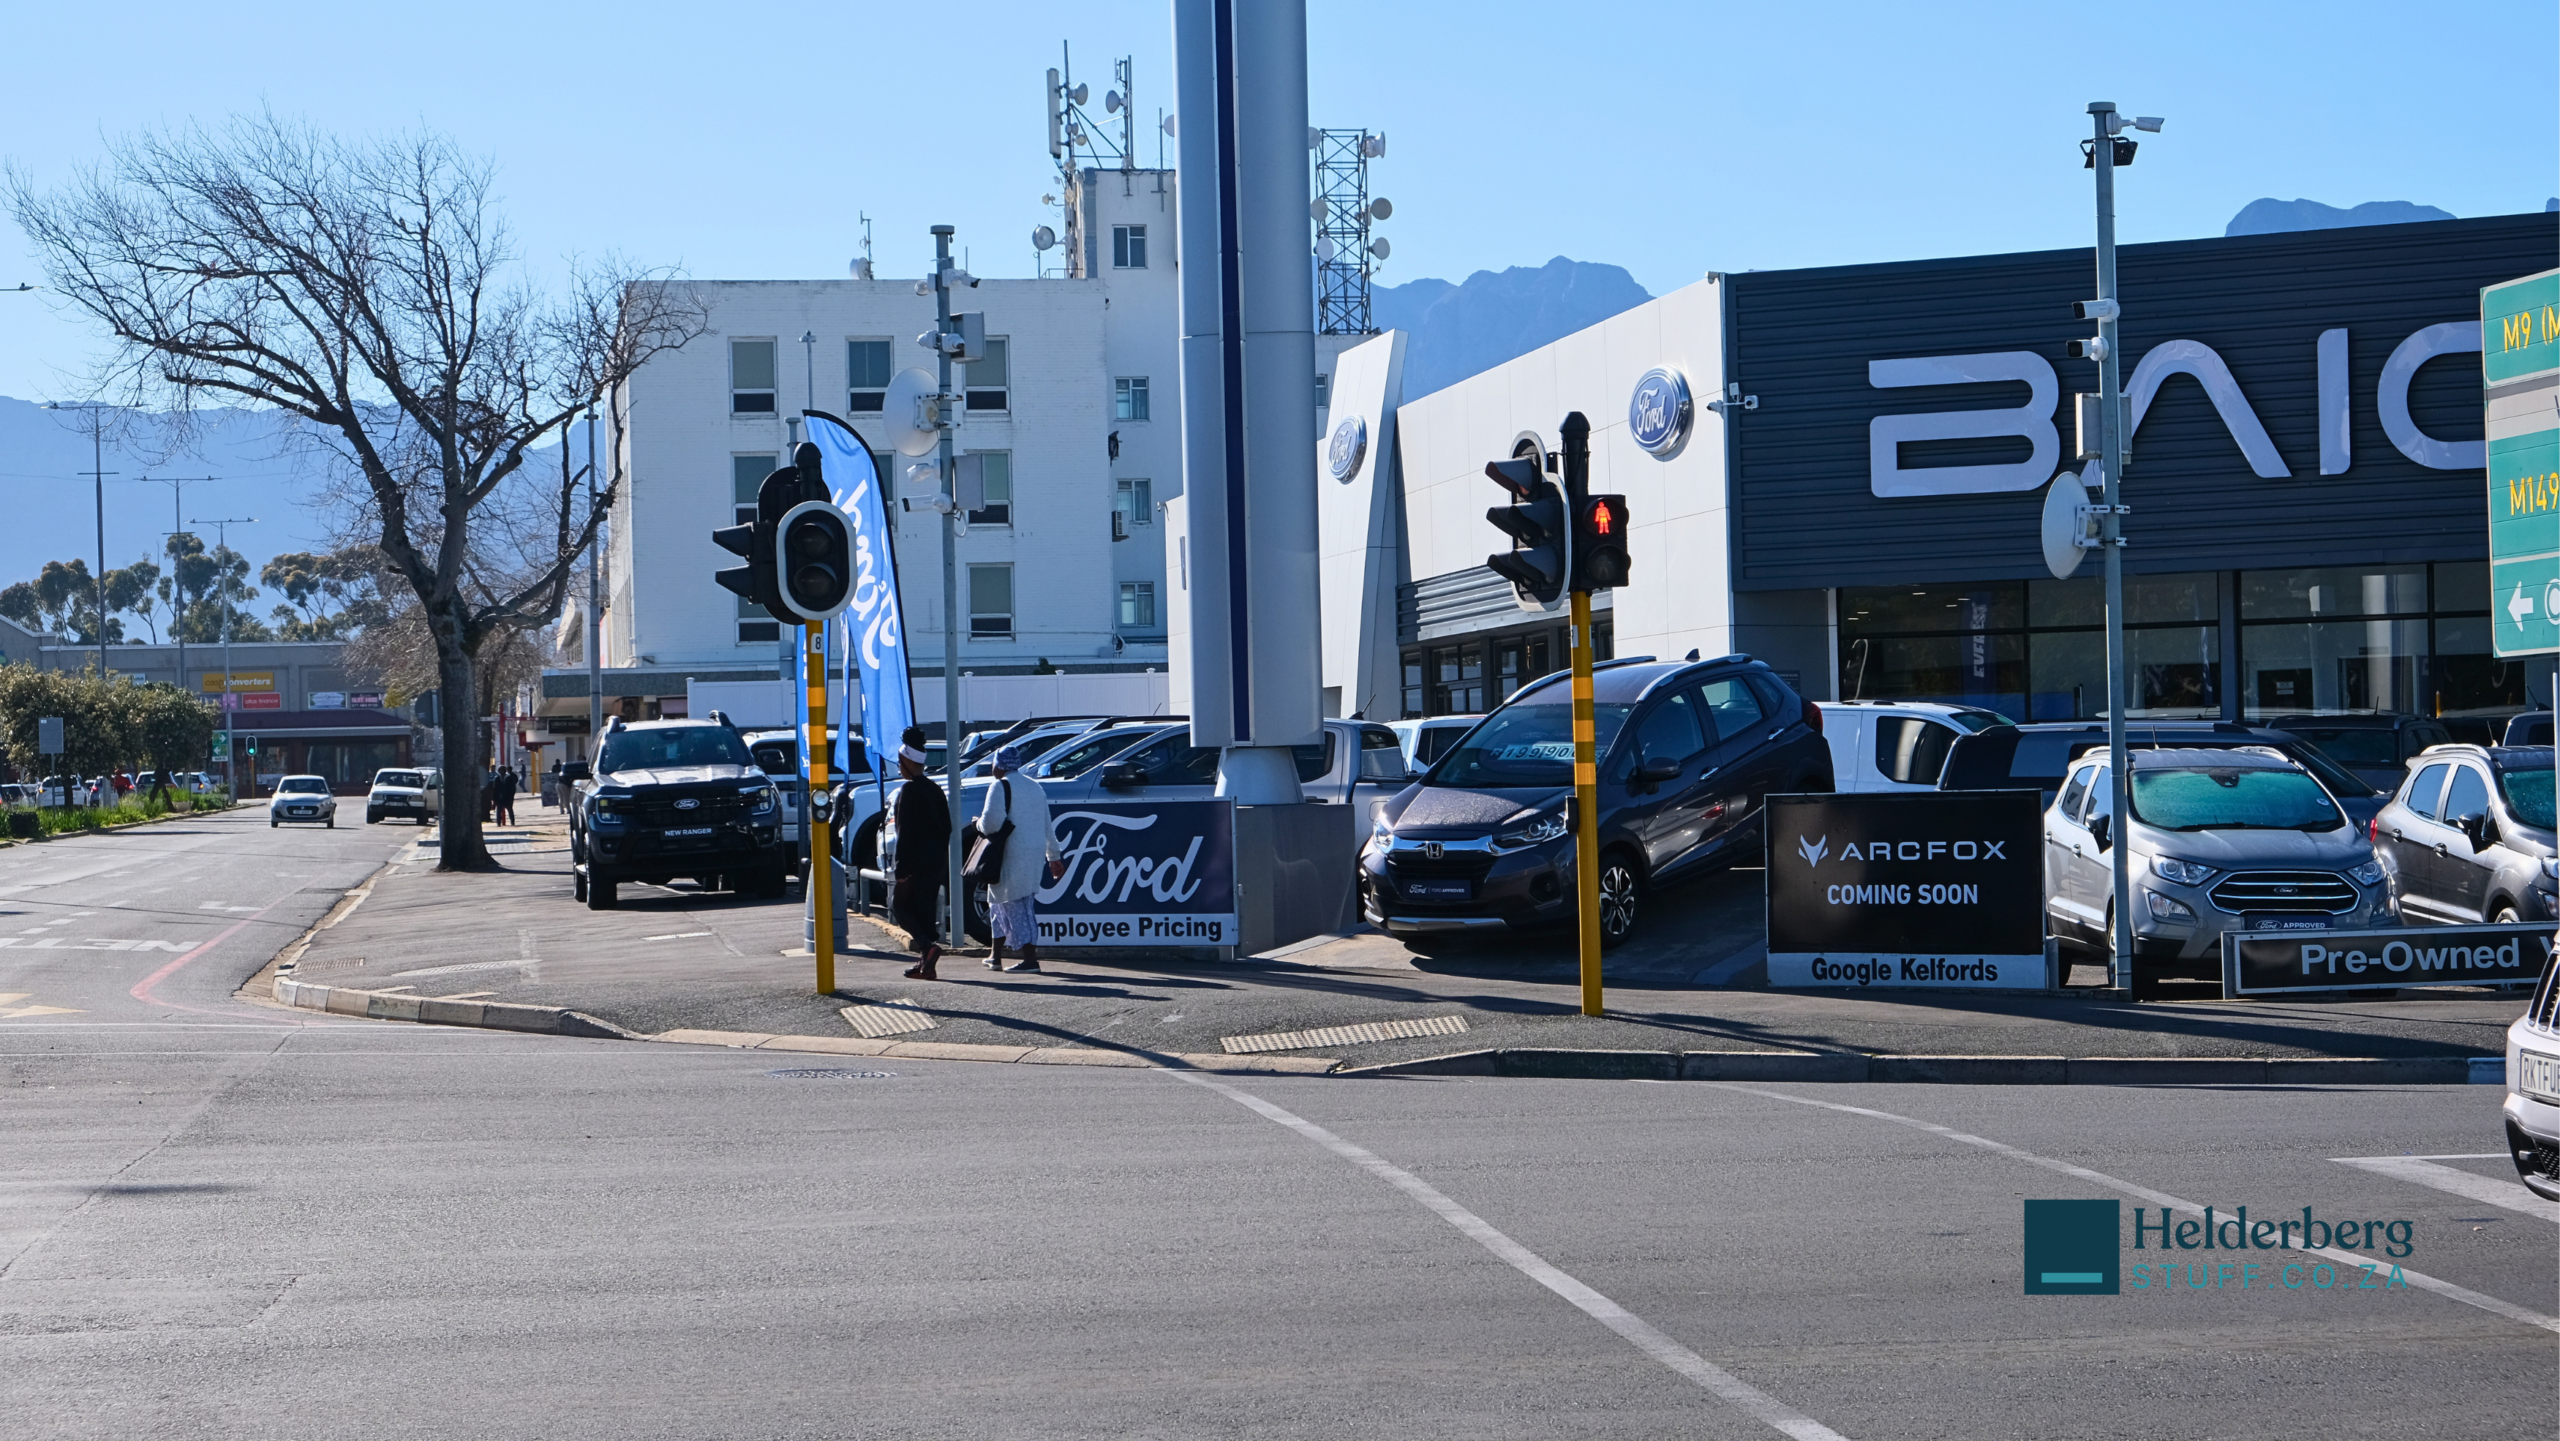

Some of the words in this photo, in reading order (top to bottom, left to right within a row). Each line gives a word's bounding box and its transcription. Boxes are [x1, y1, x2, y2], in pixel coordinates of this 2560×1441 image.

[2503, 311, 2531, 353] M9
[1636, 386, 1667, 436] Ford
[1331, 428, 1353, 467] Ford
[2509, 472, 2560, 516] M149
[815, 636, 821, 650] 8
[678, 800, 695, 808] Ford
[682, 828, 712, 836] RANGER
[1034, 811, 1204, 904] Ford
[1839, 840, 2007, 861] ARCFOX
[1409, 884, 1427, 894] Ford
[1827, 884, 1911, 905] COMING
[1918, 884, 1978, 905] SOON
[1037, 917, 1131, 943] mployee
[1138, 917, 1222, 942] Pricing
[2260, 920, 2278, 930] Ford
[2283, 922, 2326, 930] APPROVED
[2301, 937, 2520, 975] Pre-Owned
[1811, 957, 1892, 986] Google
[1901, 957, 1998, 982] Kelfords
